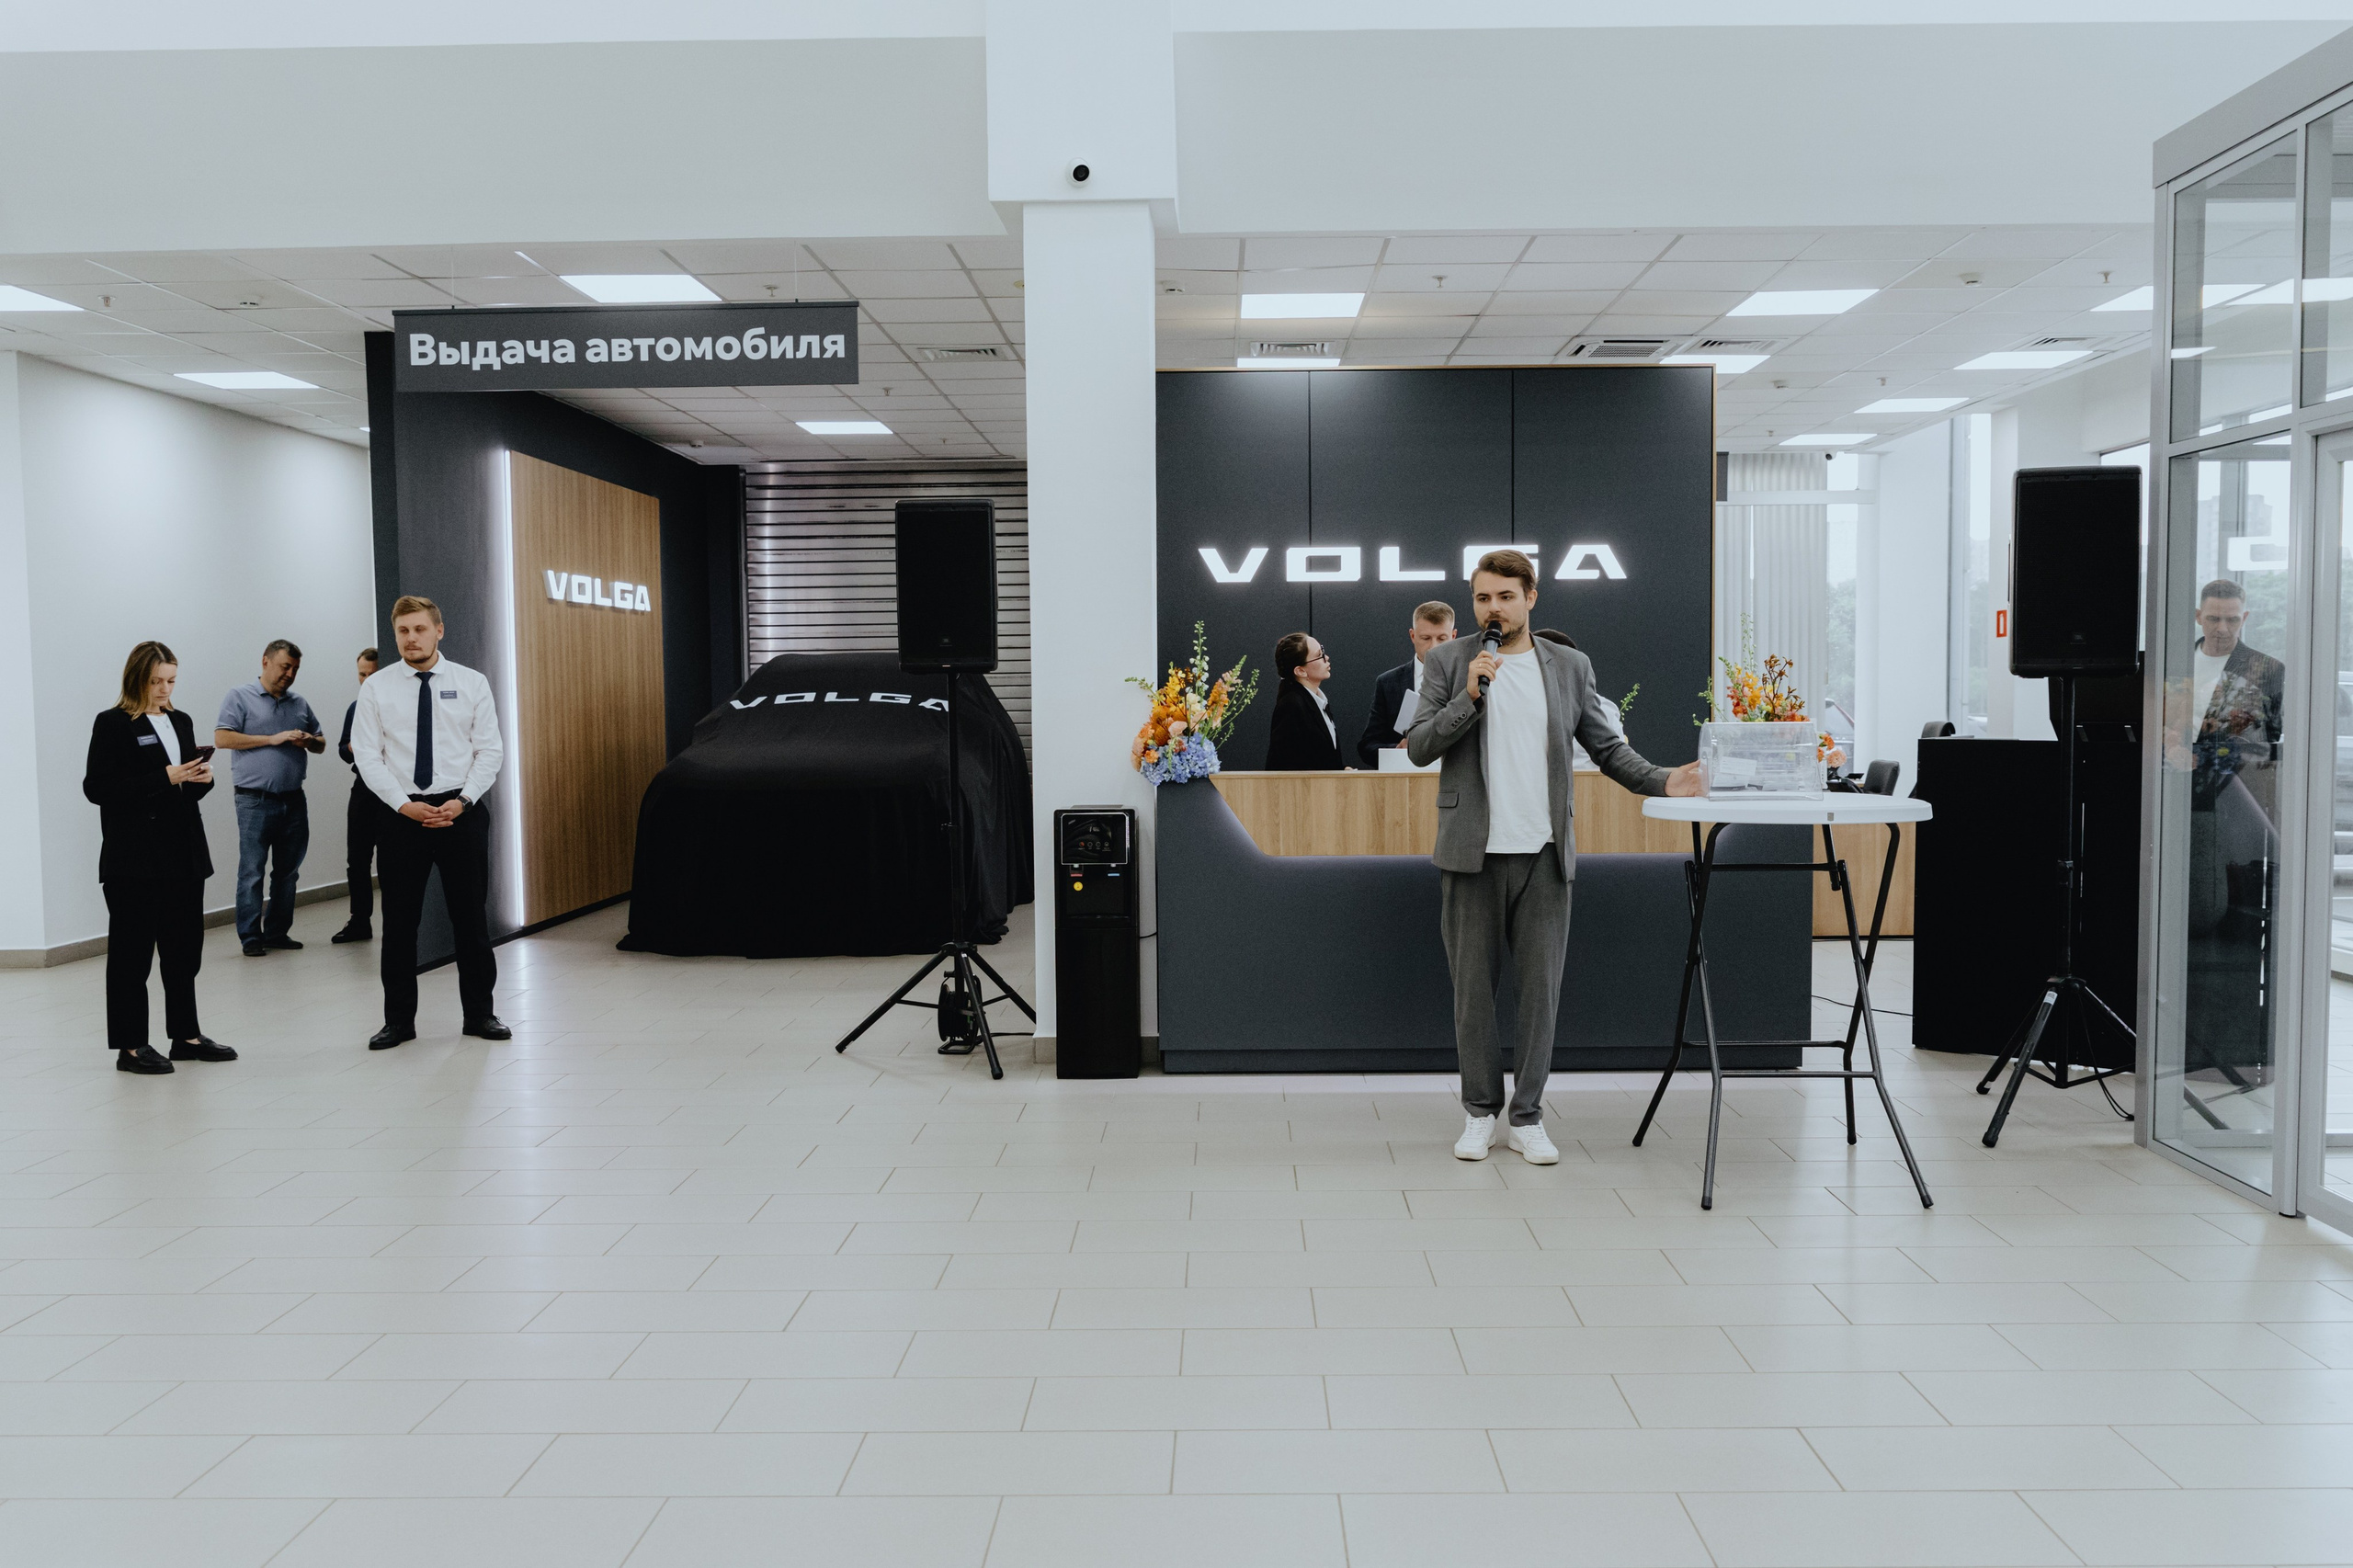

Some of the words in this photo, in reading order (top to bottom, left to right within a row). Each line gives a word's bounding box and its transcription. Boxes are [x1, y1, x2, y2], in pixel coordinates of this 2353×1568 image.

[409, 333, 576, 371] Выдача
[585, 326, 846, 363] автомобиля
[546, 569, 652, 612] VOLGA
[729, 691, 949, 712] VOLGA
